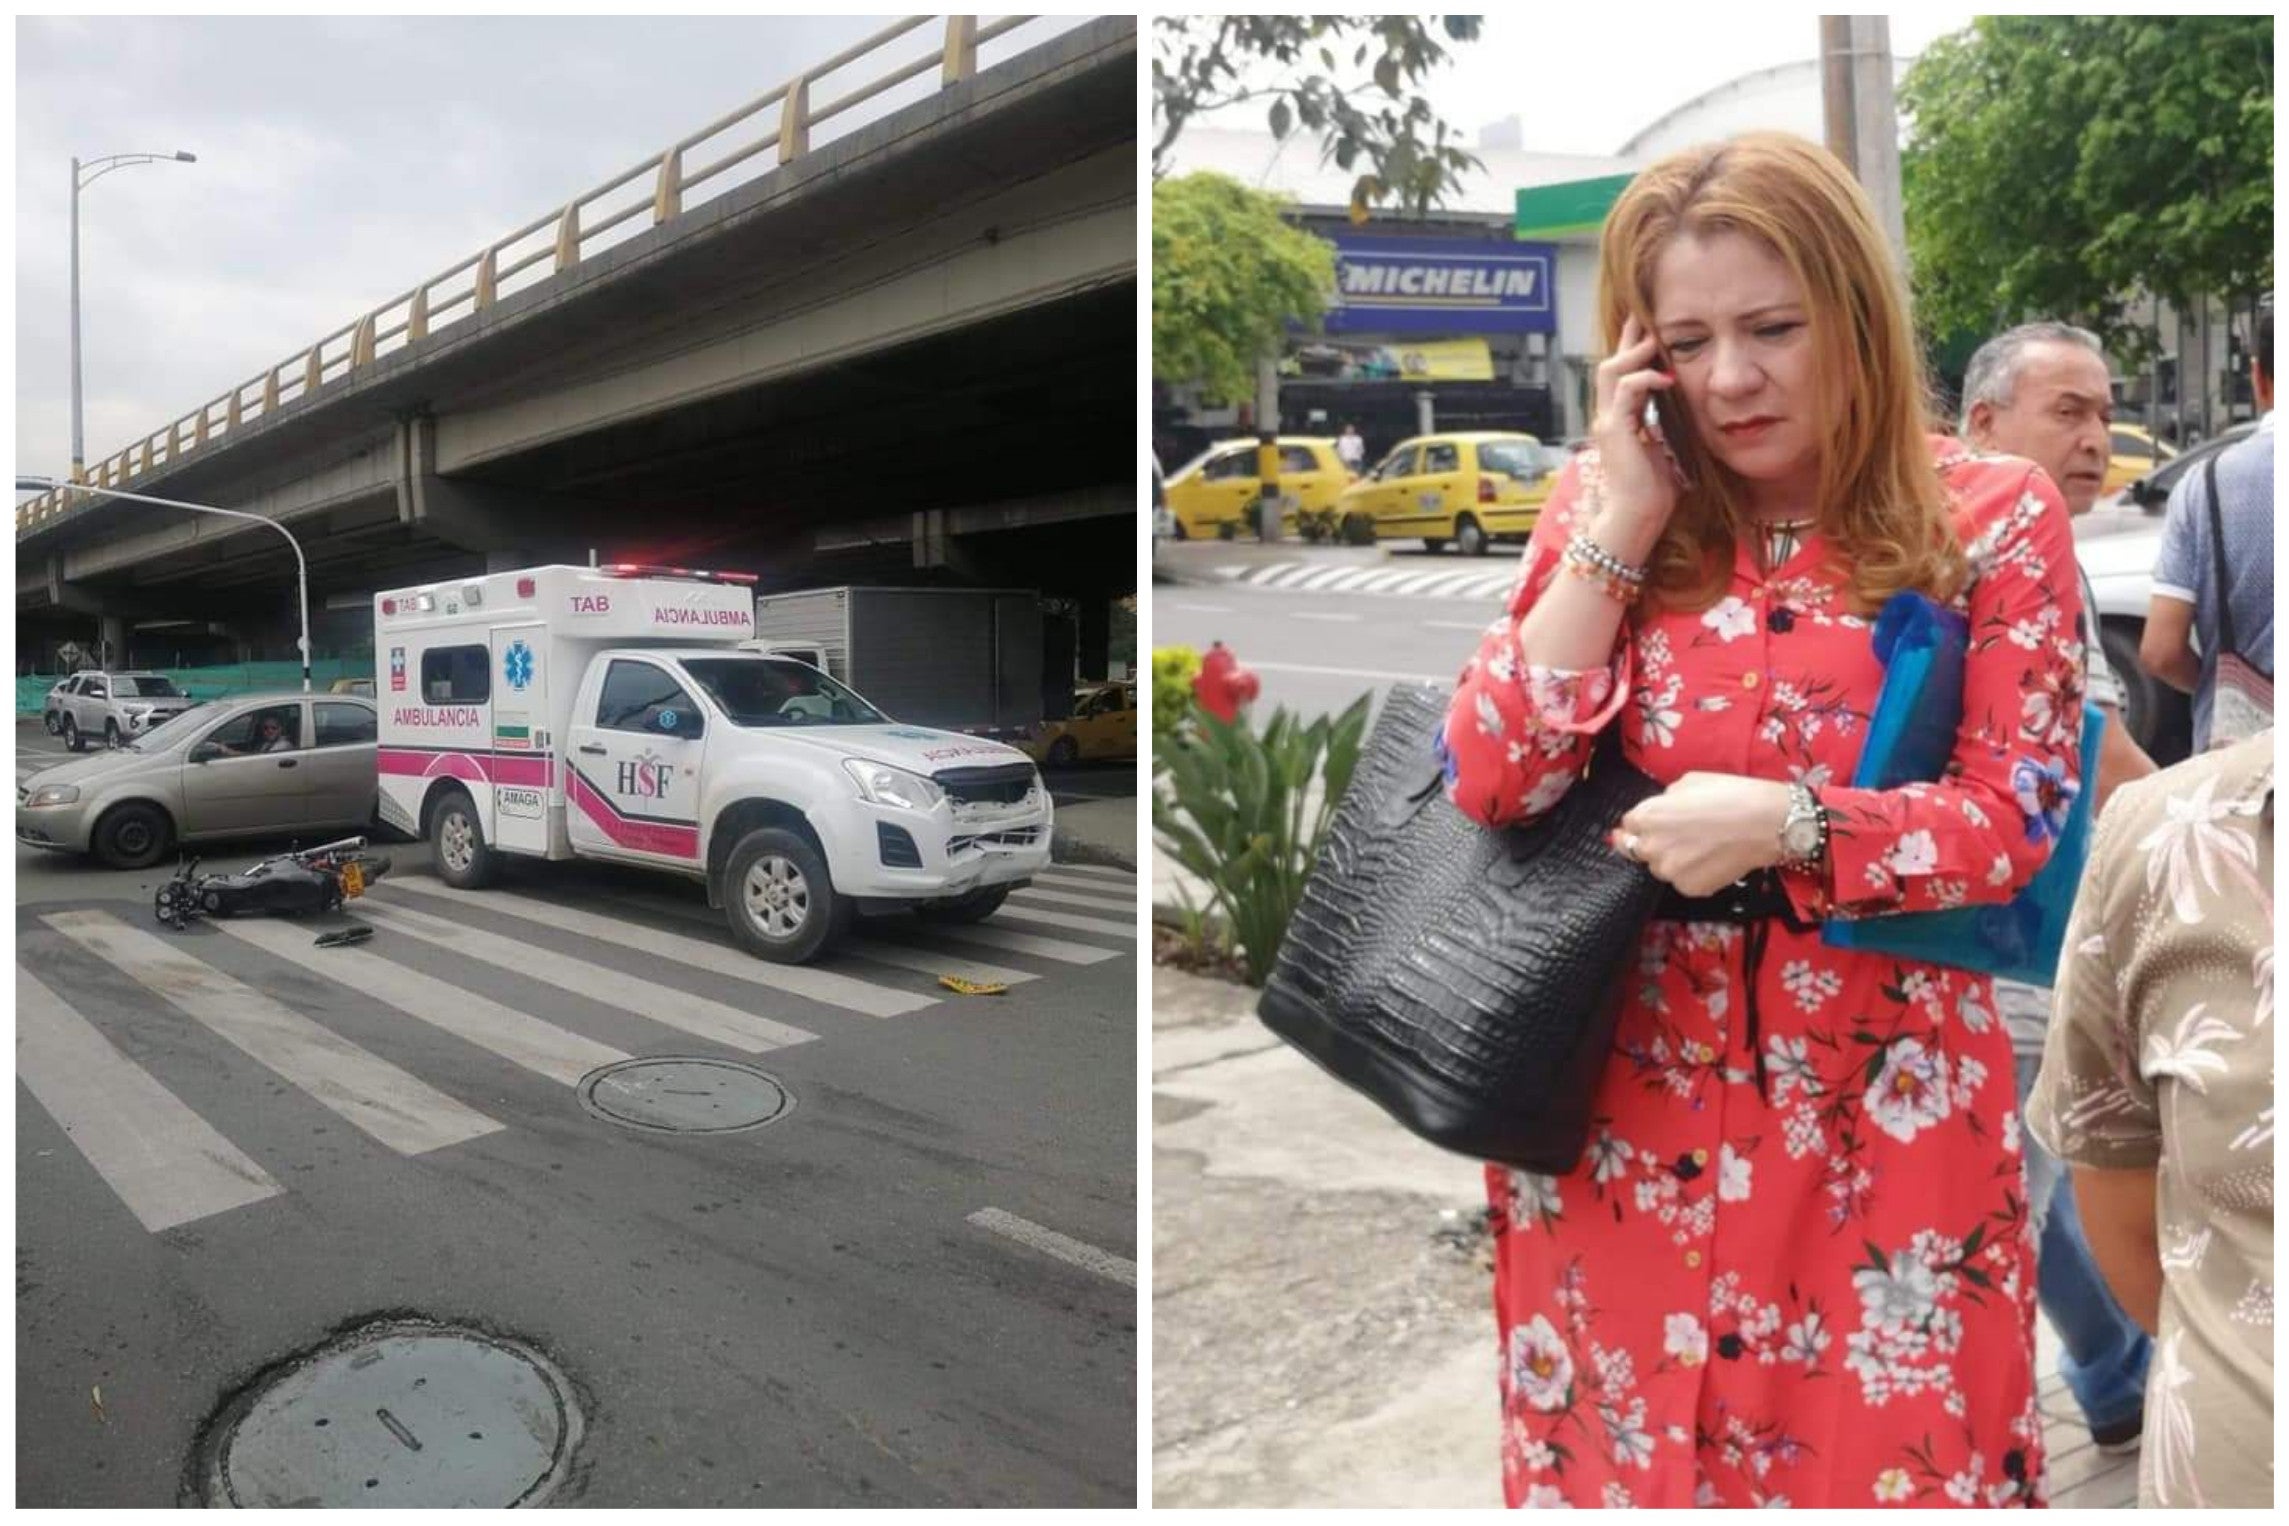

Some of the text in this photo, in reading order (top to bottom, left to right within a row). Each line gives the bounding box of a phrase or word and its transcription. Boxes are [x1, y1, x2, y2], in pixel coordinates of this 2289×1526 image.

[1343, 264, 1536, 297] MICHELIN
[570, 596, 610, 613] TAB
[394, 707, 480, 727] AMBULANCIA
[617, 760, 674, 799] HSF
[504, 792, 539, 807] AMAGA
